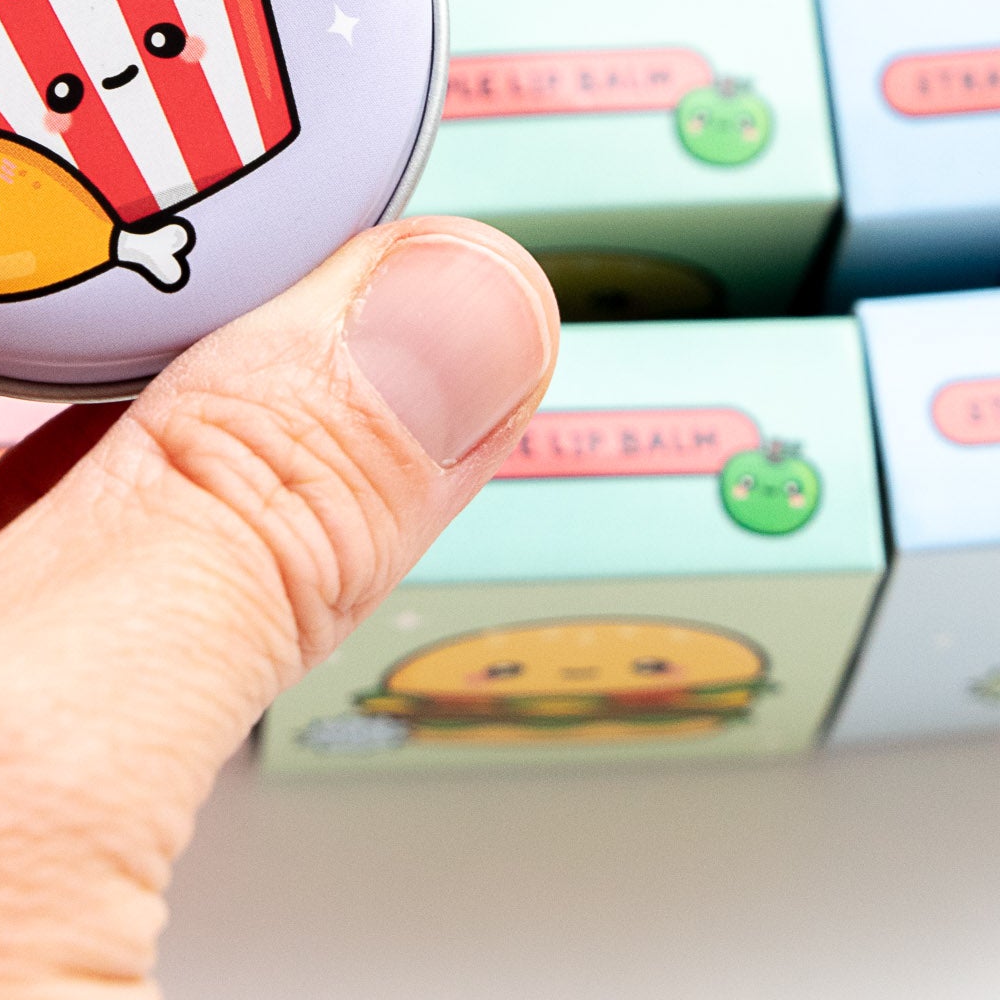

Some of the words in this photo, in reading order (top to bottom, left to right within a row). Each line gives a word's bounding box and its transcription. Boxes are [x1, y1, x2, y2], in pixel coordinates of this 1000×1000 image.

[506, 72, 558, 97] LIP
[578, 69, 671, 93] BALM
[548, 431, 602, 457] LIP
[620, 431, 718, 456] BALM
